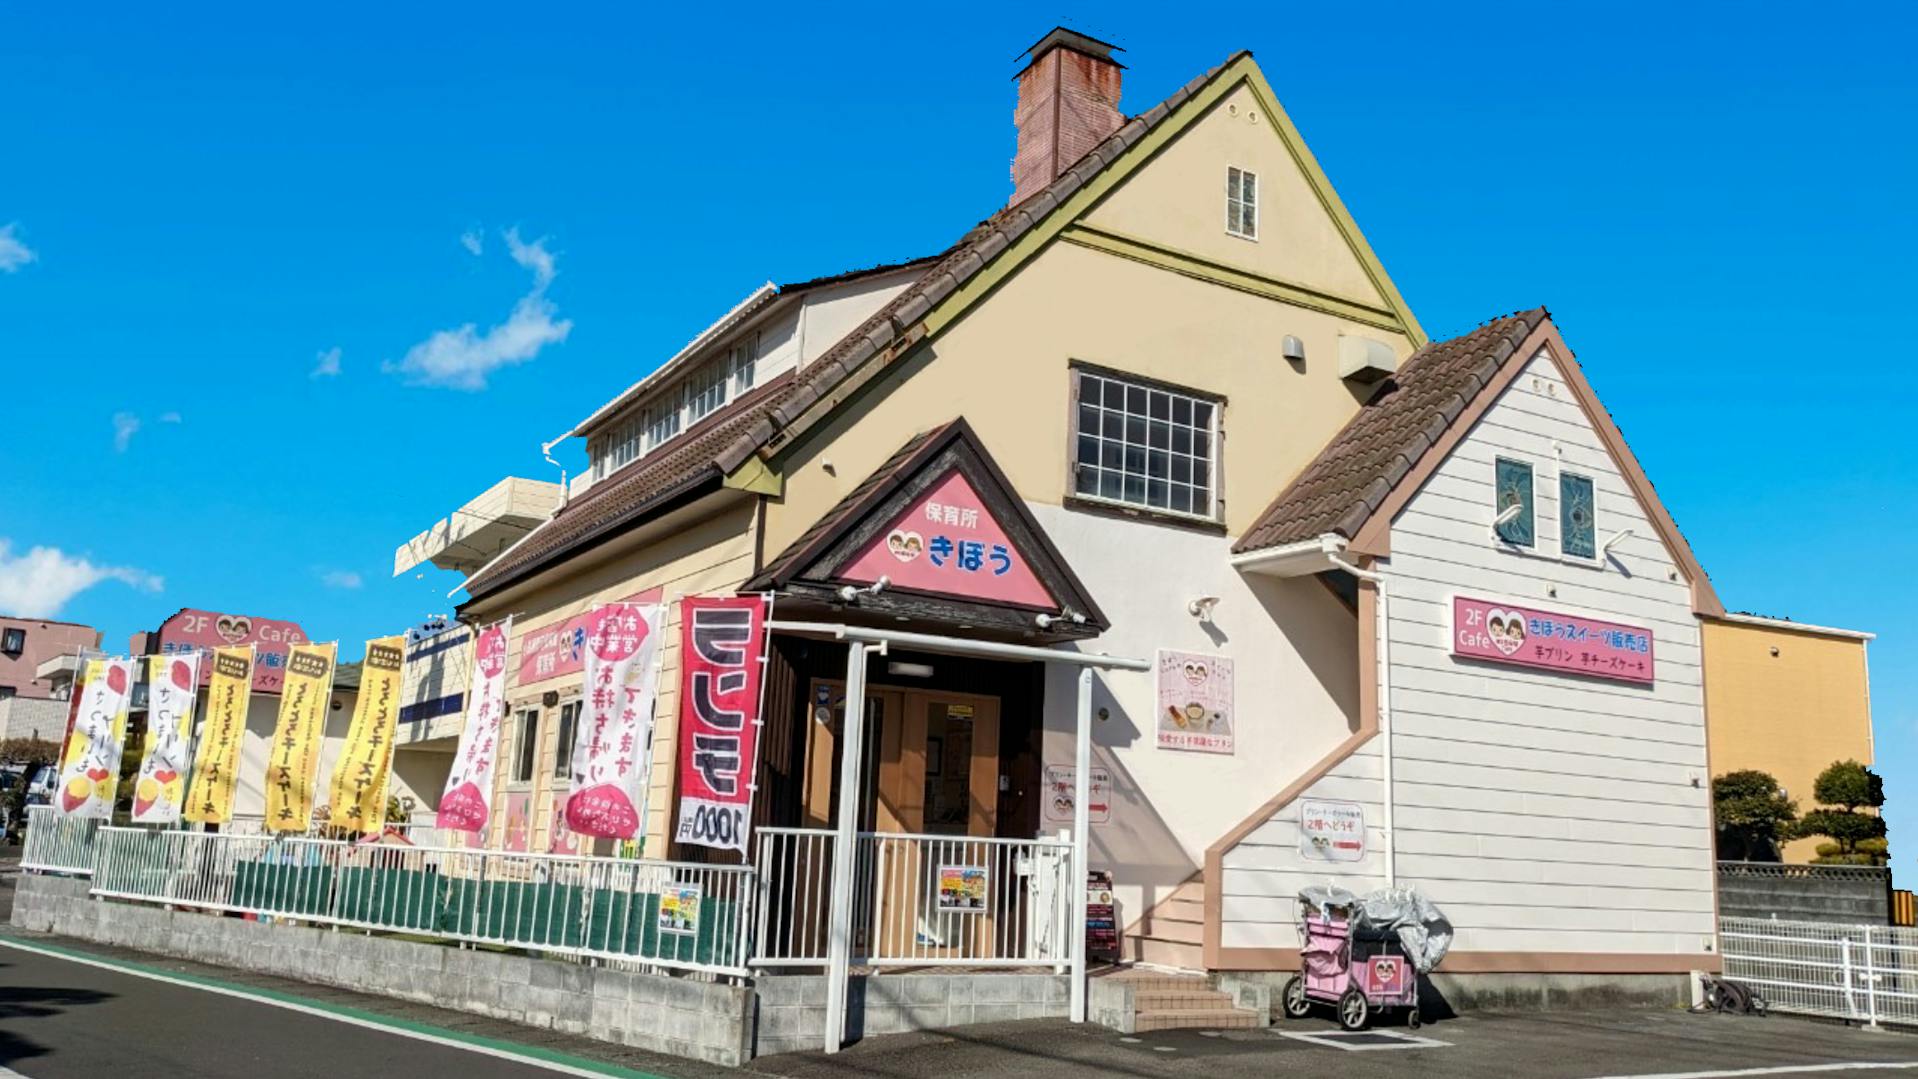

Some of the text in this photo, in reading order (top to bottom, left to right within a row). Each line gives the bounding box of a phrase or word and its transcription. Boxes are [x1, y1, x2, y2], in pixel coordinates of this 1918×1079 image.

[925, 501, 979, 529] 保育所
[928, 535, 1013, 576] きぼう
[182, 615, 302, 643] 2F Cafe
[1465, 607, 1483, 626] 2F
[1458, 629, 1491, 649] Cafe
[1529, 618, 1649, 654] きぼうスイーツ販売店
[1535, 645, 1573, 662] 芋プリン
[1581, 652, 1645, 673] 芋チーズケーキ
[1307, 818, 1356, 832] 2階へどうぞ
